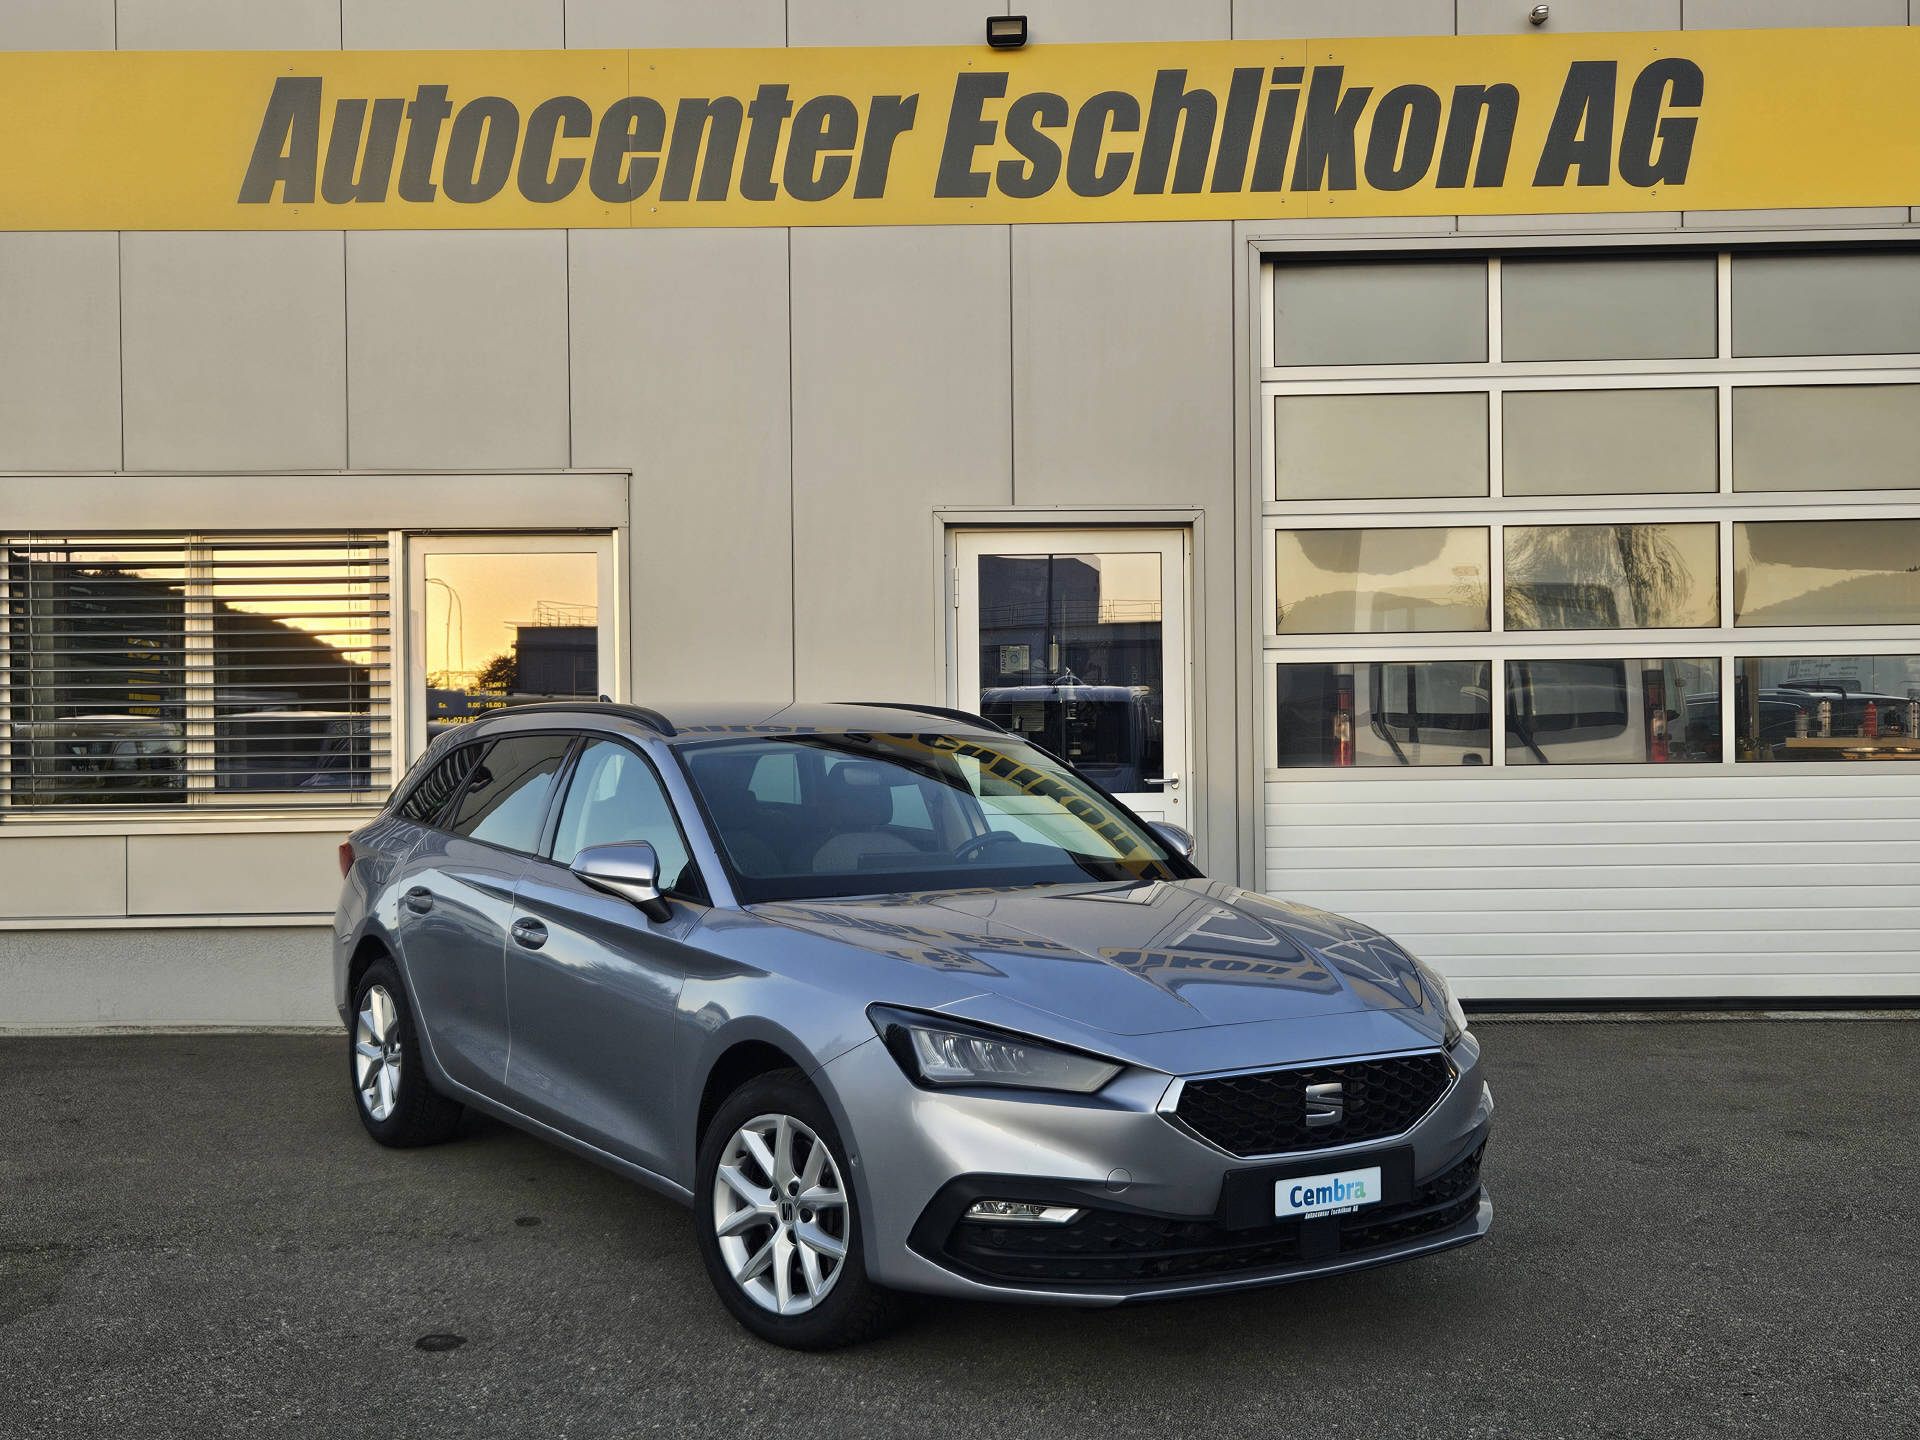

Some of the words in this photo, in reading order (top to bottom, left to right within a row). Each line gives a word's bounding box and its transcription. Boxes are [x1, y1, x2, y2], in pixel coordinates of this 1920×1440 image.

[238, 76, 919, 204] Autocenter
[934, 66, 1519, 198] Eschlikon
[1532, 58, 1704, 187] AG
[1290, 1178, 1366, 1208] Cembra
